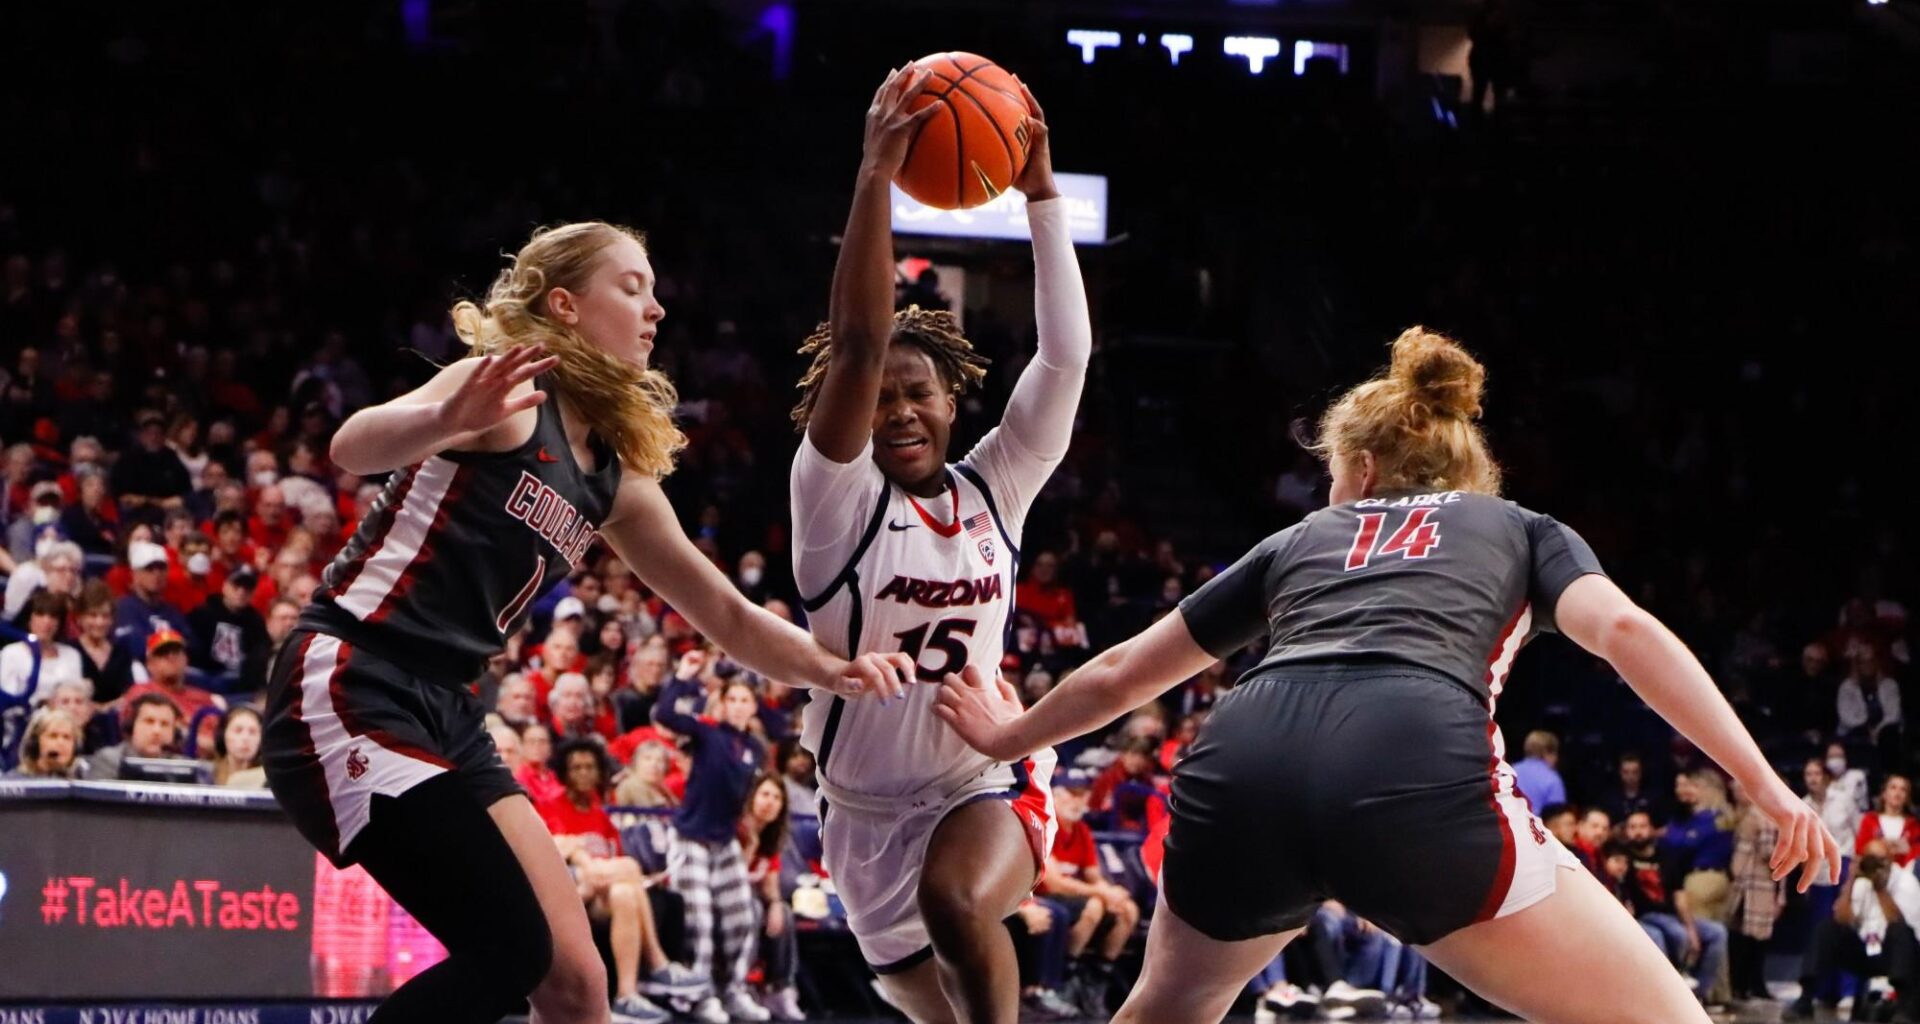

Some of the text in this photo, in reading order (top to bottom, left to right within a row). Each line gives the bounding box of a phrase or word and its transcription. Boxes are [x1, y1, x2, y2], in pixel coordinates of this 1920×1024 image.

[1354, 490, 1467, 508] CLARKE
[1344, 507, 1441, 572] 14
[496, 555, 546, 634] 1
[875, 573, 1002, 608] ARIZONA
[894, 618, 977, 683] 15
[41, 877, 300, 929] #TakeATaste
[143, 1007, 197, 1024] HOME
[204, 1007, 261, 1024] LOANS
